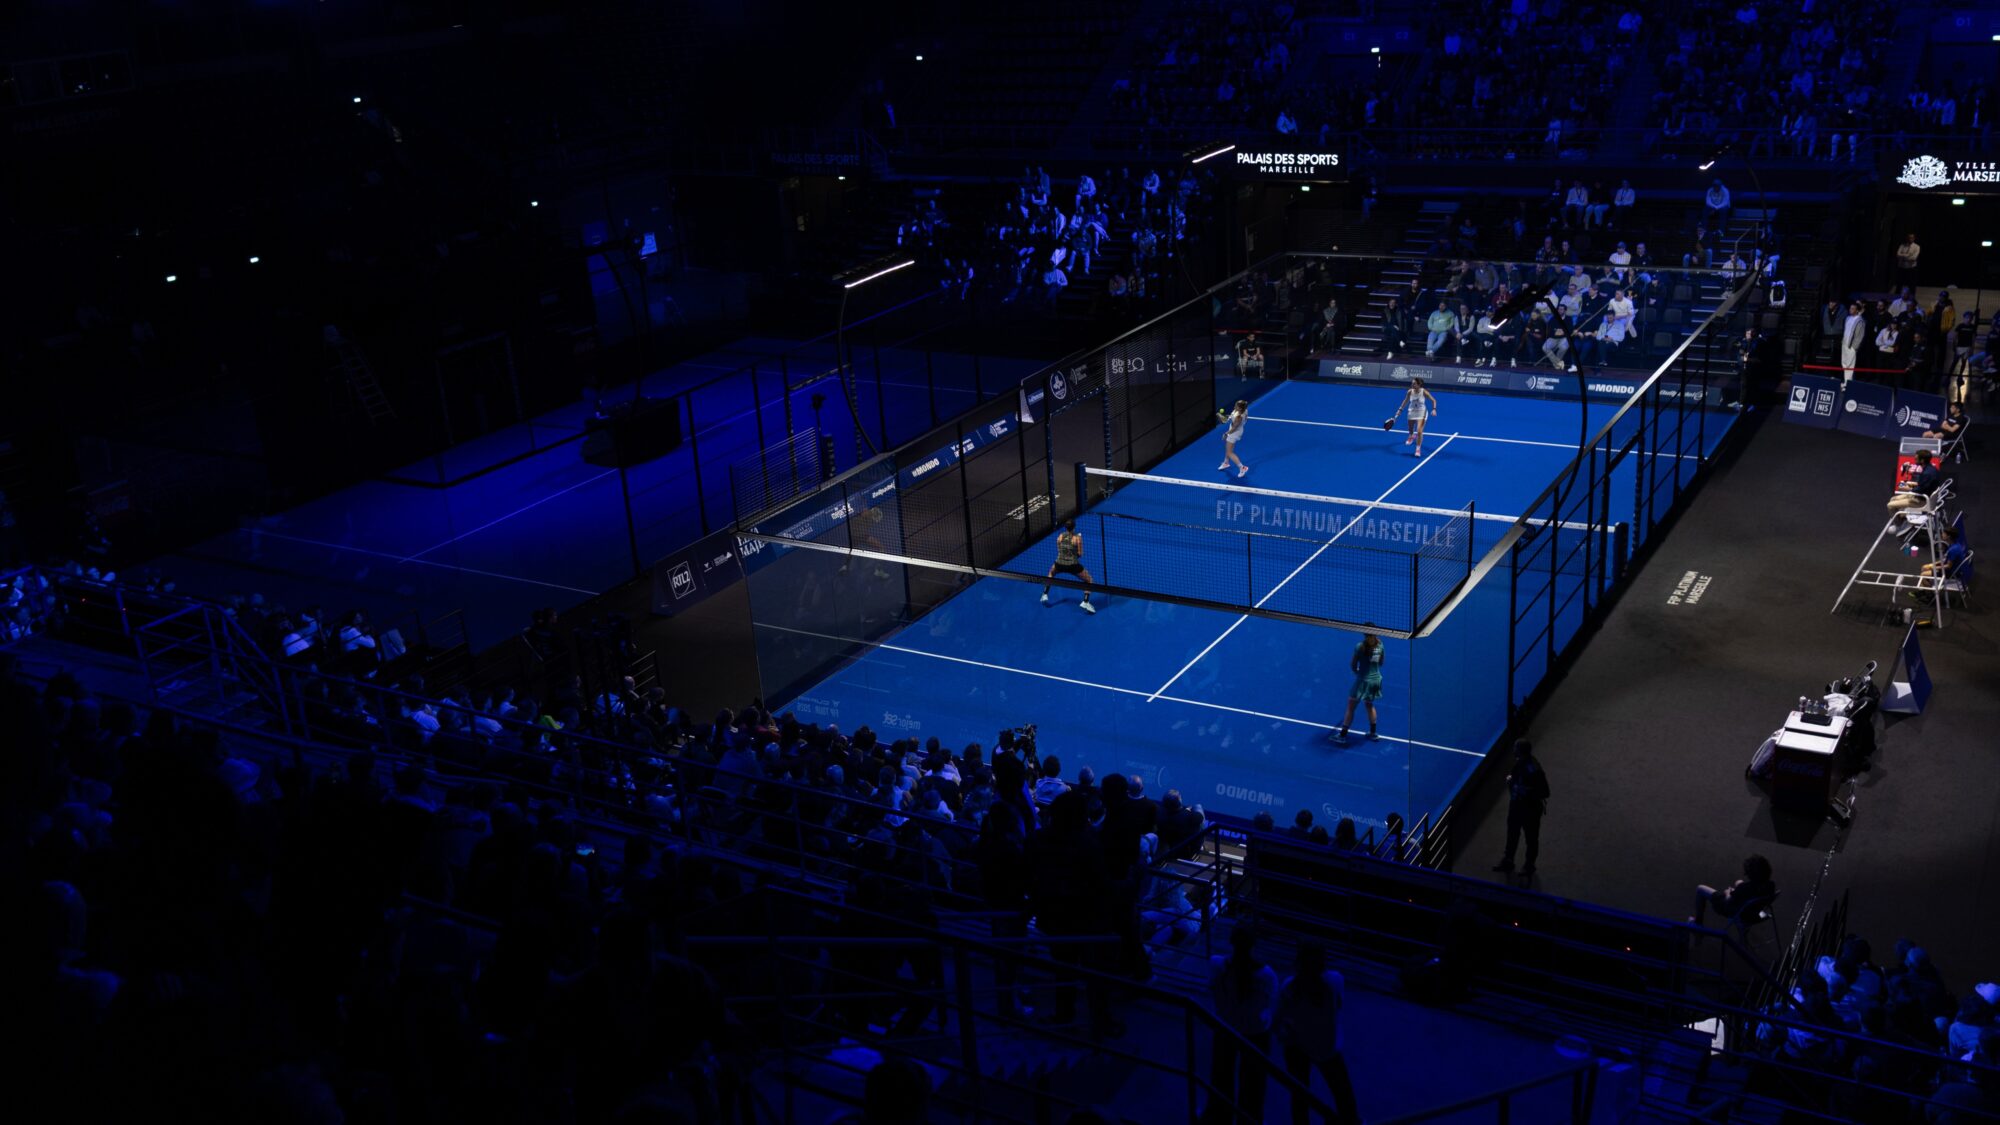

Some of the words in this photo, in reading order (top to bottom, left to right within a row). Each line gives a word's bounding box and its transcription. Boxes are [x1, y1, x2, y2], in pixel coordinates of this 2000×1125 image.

[1236, 153, 1272, 165] PALAIS
[1274, 154, 1295, 165] DES
[1297, 154, 1339, 166] SPORTS
[1259, 165, 1315, 174] MARSEILLE
[1955, 162, 1996, 170] VILLE
[1594, 383, 1635, 395] MONDO
[1216, 500, 1243, 521] FIP
[1250, 504, 1342, 534] PLATINUM
[1348, 515, 1457, 548] MARSEILLE
[672, 570, 691, 588] RTL2
